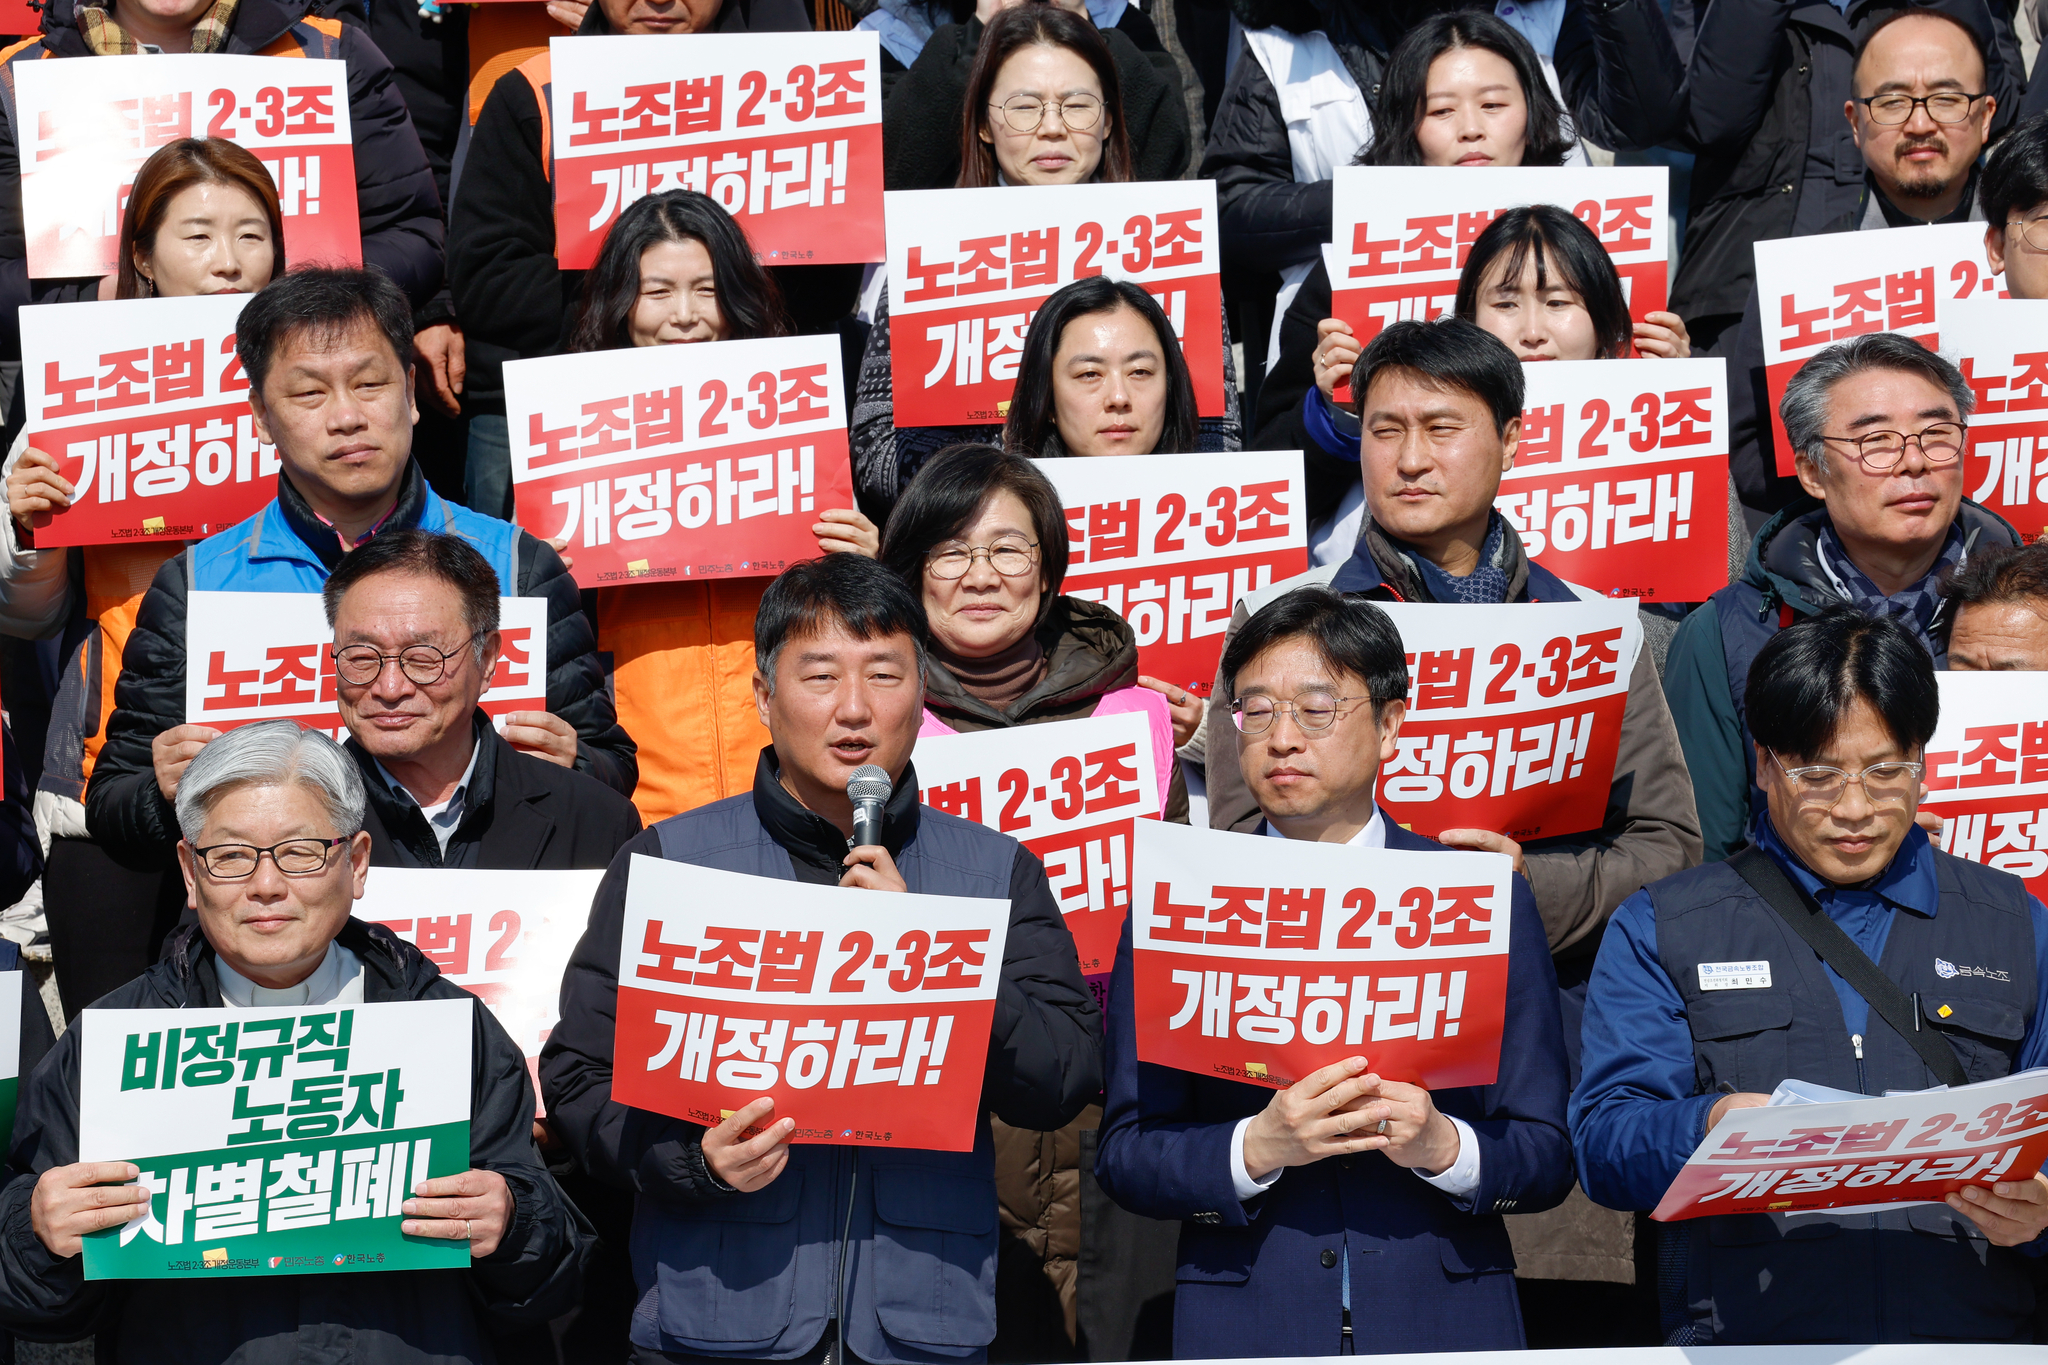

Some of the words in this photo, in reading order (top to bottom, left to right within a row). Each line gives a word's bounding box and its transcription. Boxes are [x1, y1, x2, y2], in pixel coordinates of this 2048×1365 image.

[207, 85, 335, 138] 2·3조
[570, 75, 723, 147] 노조법
[736, 59, 865, 128] 2·3조
[781, 250, 814, 260] 한국노총
[904, 226, 1060, 304] 노조법
[1073, 208, 1202, 281] 2·3조
[1779, 266, 1936, 352] 노조법
[43, 338, 204, 420] 노조법
[527, 385, 683, 470] 노조법
[698, 363, 829, 438] 2·3조
[966, 411, 987, 419] 노조법
[66, 414, 283, 506] 개정하
[1578, 386, 1712, 459] 2·3조
[111, 528, 132, 538] 노조법
[551, 445, 815, 548] 개정하라!
[1154, 479, 1289, 554] 2·3조
[1495, 471, 1694, 559] 정하라!
[597, 571, 617, 581] 노조법
[698, 563, 733, 574] 민주노총
[752, 560, 785, 571] 한국노총
[1622, 588, 1655, 597] 한국노총
[203, 642, 337, 711] 노조
[1484, 627, 1623, 705] 2·3조
[998, 742, 1141, 833] 2·3조
[1382, 712, 1595, 803] 정하라!
[1149, 881, 1326, 950] 노조법
[1336, 885, 1494, 950] 2·3조
[635, 919, 824, 994] 노조법
[829, 929, 991, 993] 2·3조
[1959, 964, 2011, 982] 금속노조
[1169, 969, 1467, 1046] 개정하라!
[120, 1009, 355, 1092] 비정규직
[646, 1009, 954, 1091] 개정하라!
[1213, 1063, 1235, 1077] 노조법
[226, 1067, 404, 1146] 노동자
[688, 1107, 709, 1121] 노조법
[794, 1129, 834, 1139] 민주노총
[855, 1130, 893, 1141] 한국노총
[1707, 1118, 1910, 1160] 노조법
[119, 1138, 432, 1247] 차별철폐!
[1698, 1145, 2023, 1204] 개정하라!
[167, 1260, 191, 1271] 노조법
[213, 1258, 259, 1270] 개정운동본부
[284, 1256, 325, 1267] 민주노총
[347, 1252, 386, 1264] 한국노총
